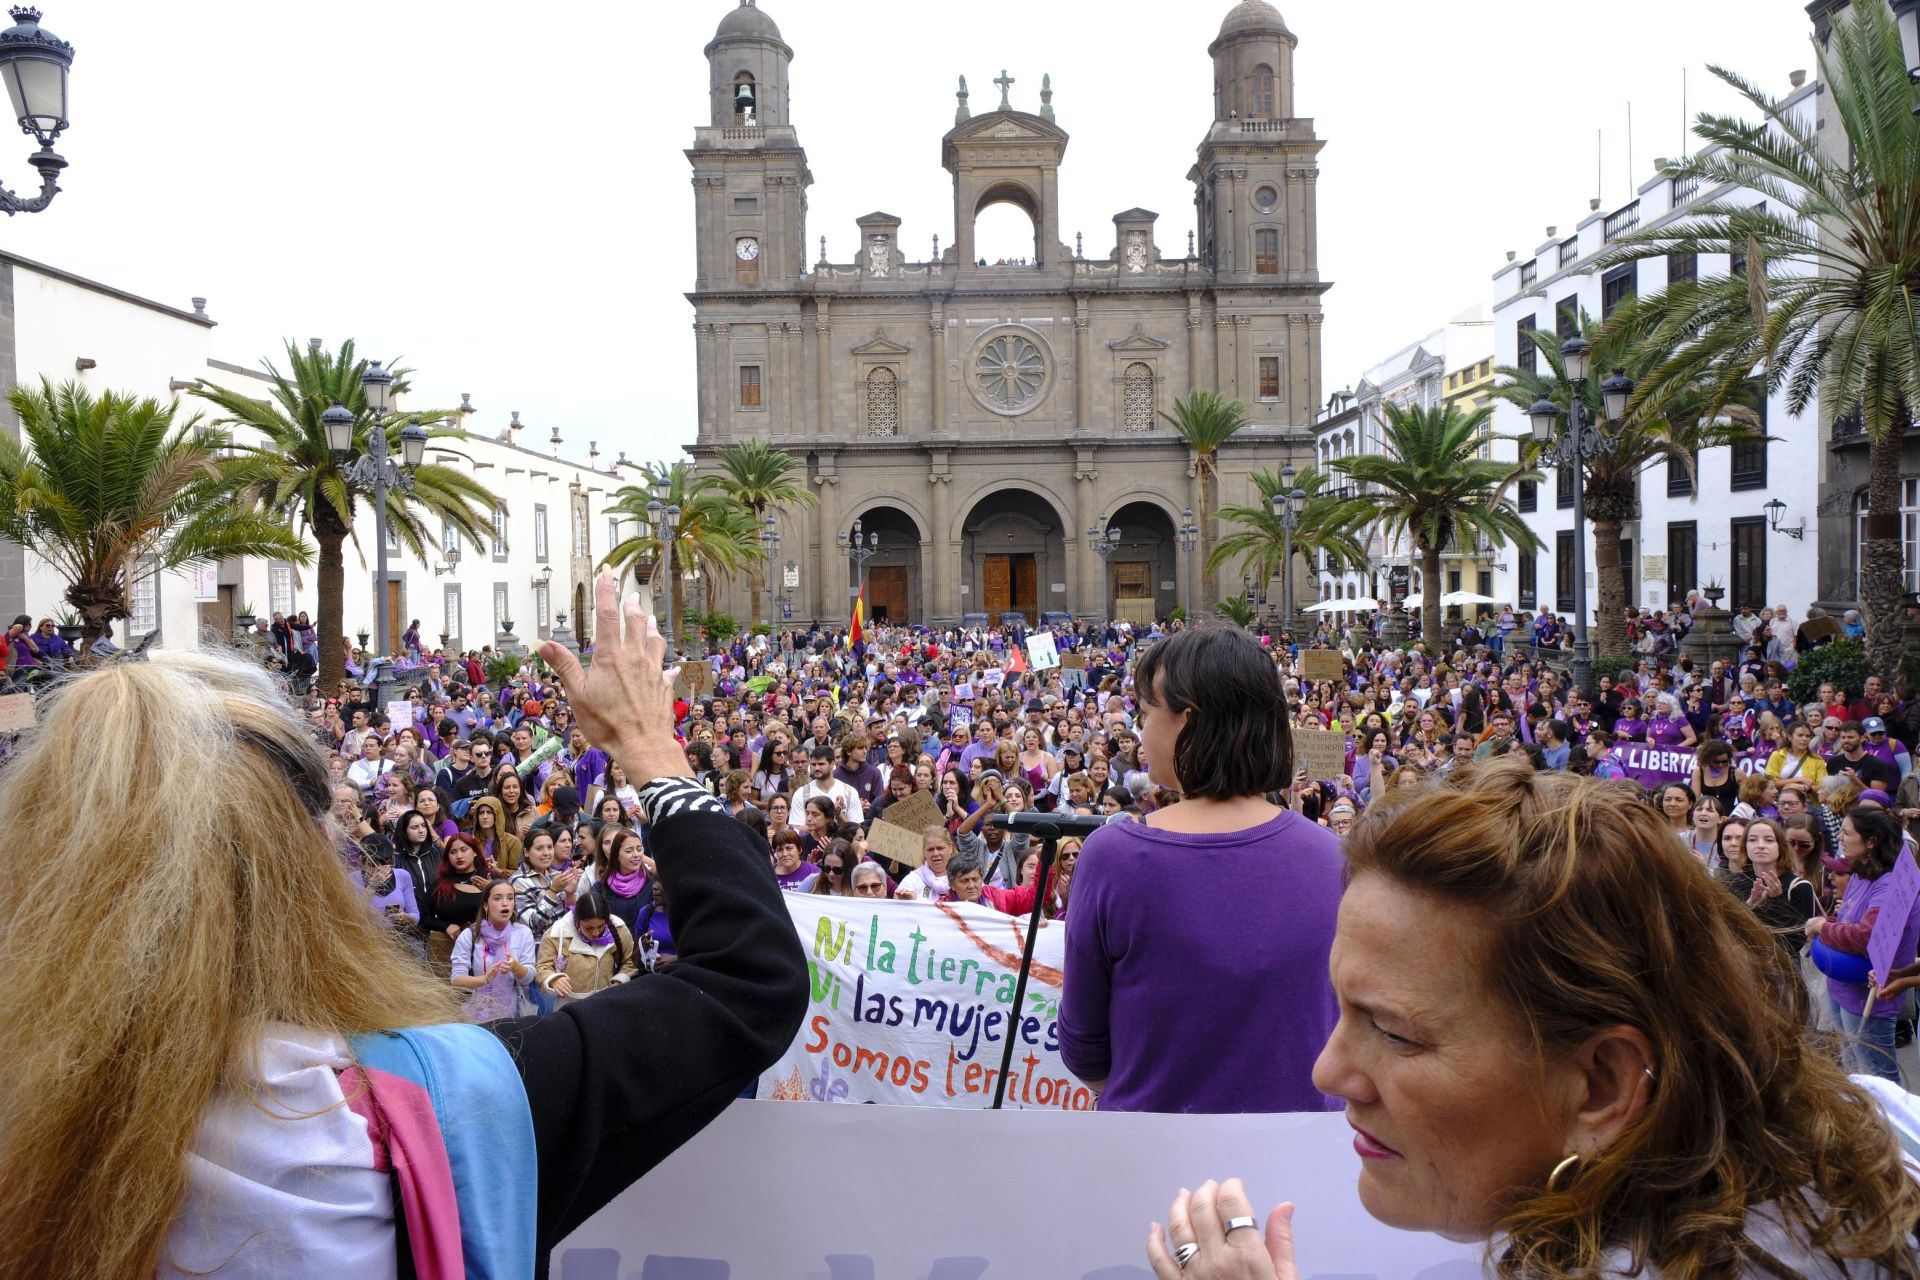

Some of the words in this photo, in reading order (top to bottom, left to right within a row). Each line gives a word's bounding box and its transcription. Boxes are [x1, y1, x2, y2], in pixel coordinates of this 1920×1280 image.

[1732, 756, 1767, 778] OS
[892, 795, 922, 817] LIBRES
[814, 916, 856, 966] Ni
[866, 914, 898, 974] la
[908, 925, 1018, 1004] tierra
[853, 973, 904, 1027] las
[805, 1015, 931, 1094] Somos
